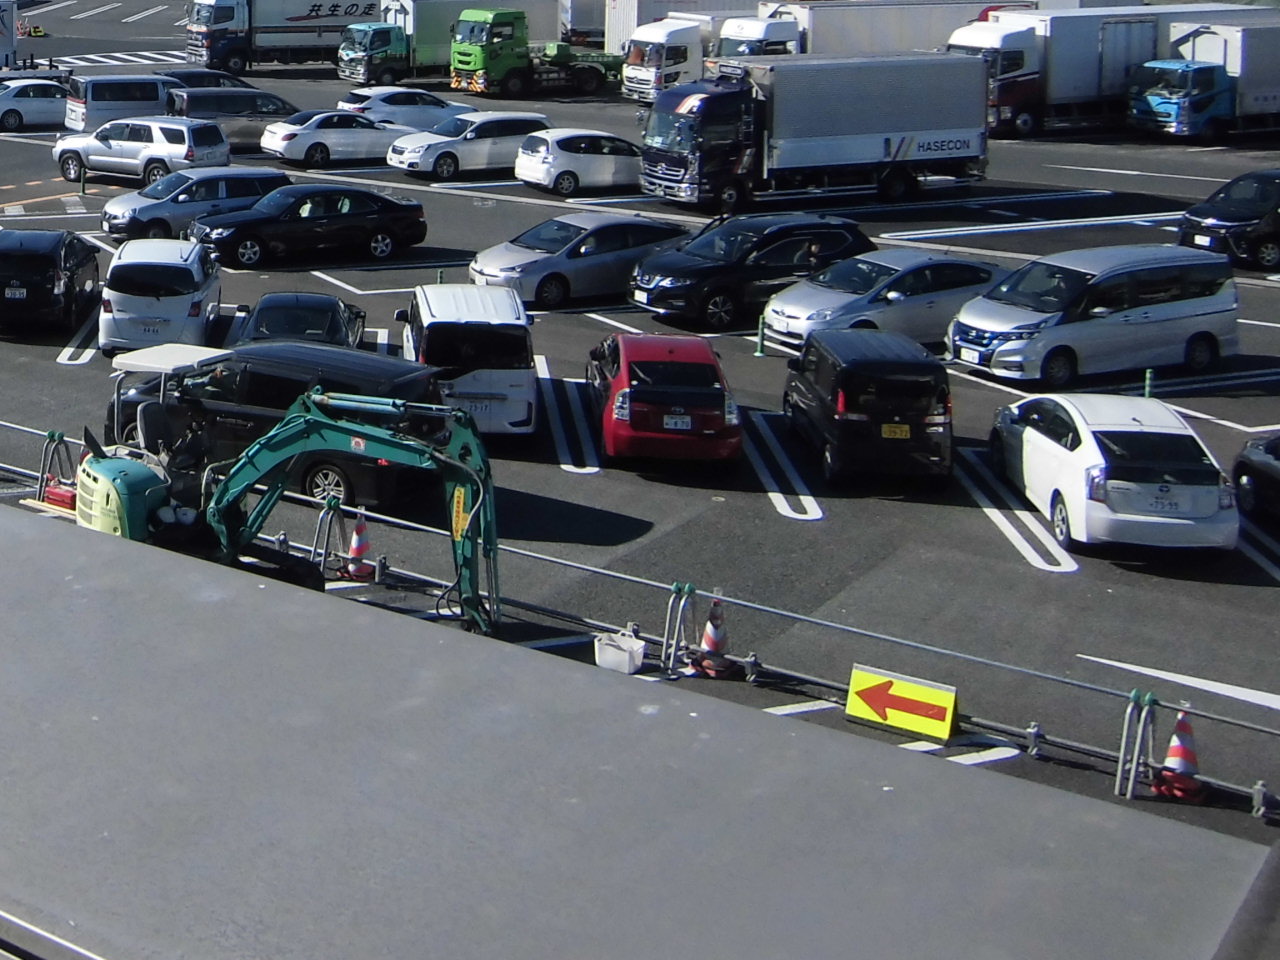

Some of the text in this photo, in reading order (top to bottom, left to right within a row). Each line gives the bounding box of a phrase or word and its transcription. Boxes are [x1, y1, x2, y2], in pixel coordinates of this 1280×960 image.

[306, 3, 377, 16] 共生の走
[917, 139, 970, 152] HASECON
